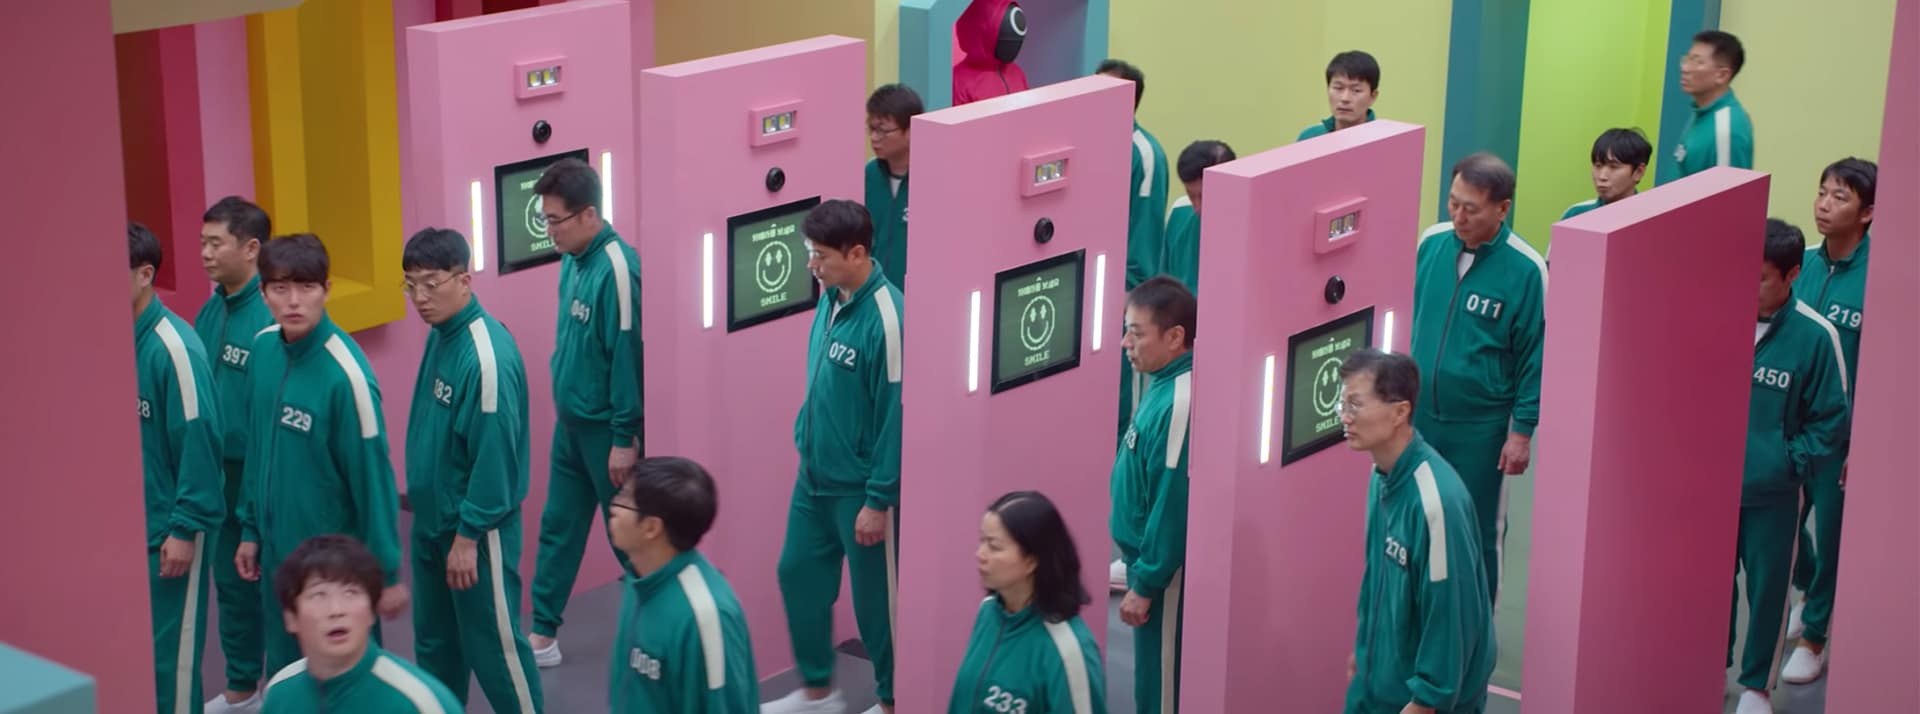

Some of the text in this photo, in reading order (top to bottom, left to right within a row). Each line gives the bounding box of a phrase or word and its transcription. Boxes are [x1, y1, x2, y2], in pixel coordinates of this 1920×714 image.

[530, 240, 555, 252] SMIL
[760, 292, 787, 307] SMILE
[1466, 294, 1502, 319] 011
[1826, 304, 1862, 328] 219
[222, 344, 249, 366] 397
[829, 341, 856, 366] 072
[1024, 350, 1050, 366] SMILE
[1753, 367, 1790, 388] 450
[280, 406, 312, 432] 229
[1315, 415, 1340, 433] SMILE
[1384, 536, 1408, 566] 279
[983, 685, 1028, 714] 233
